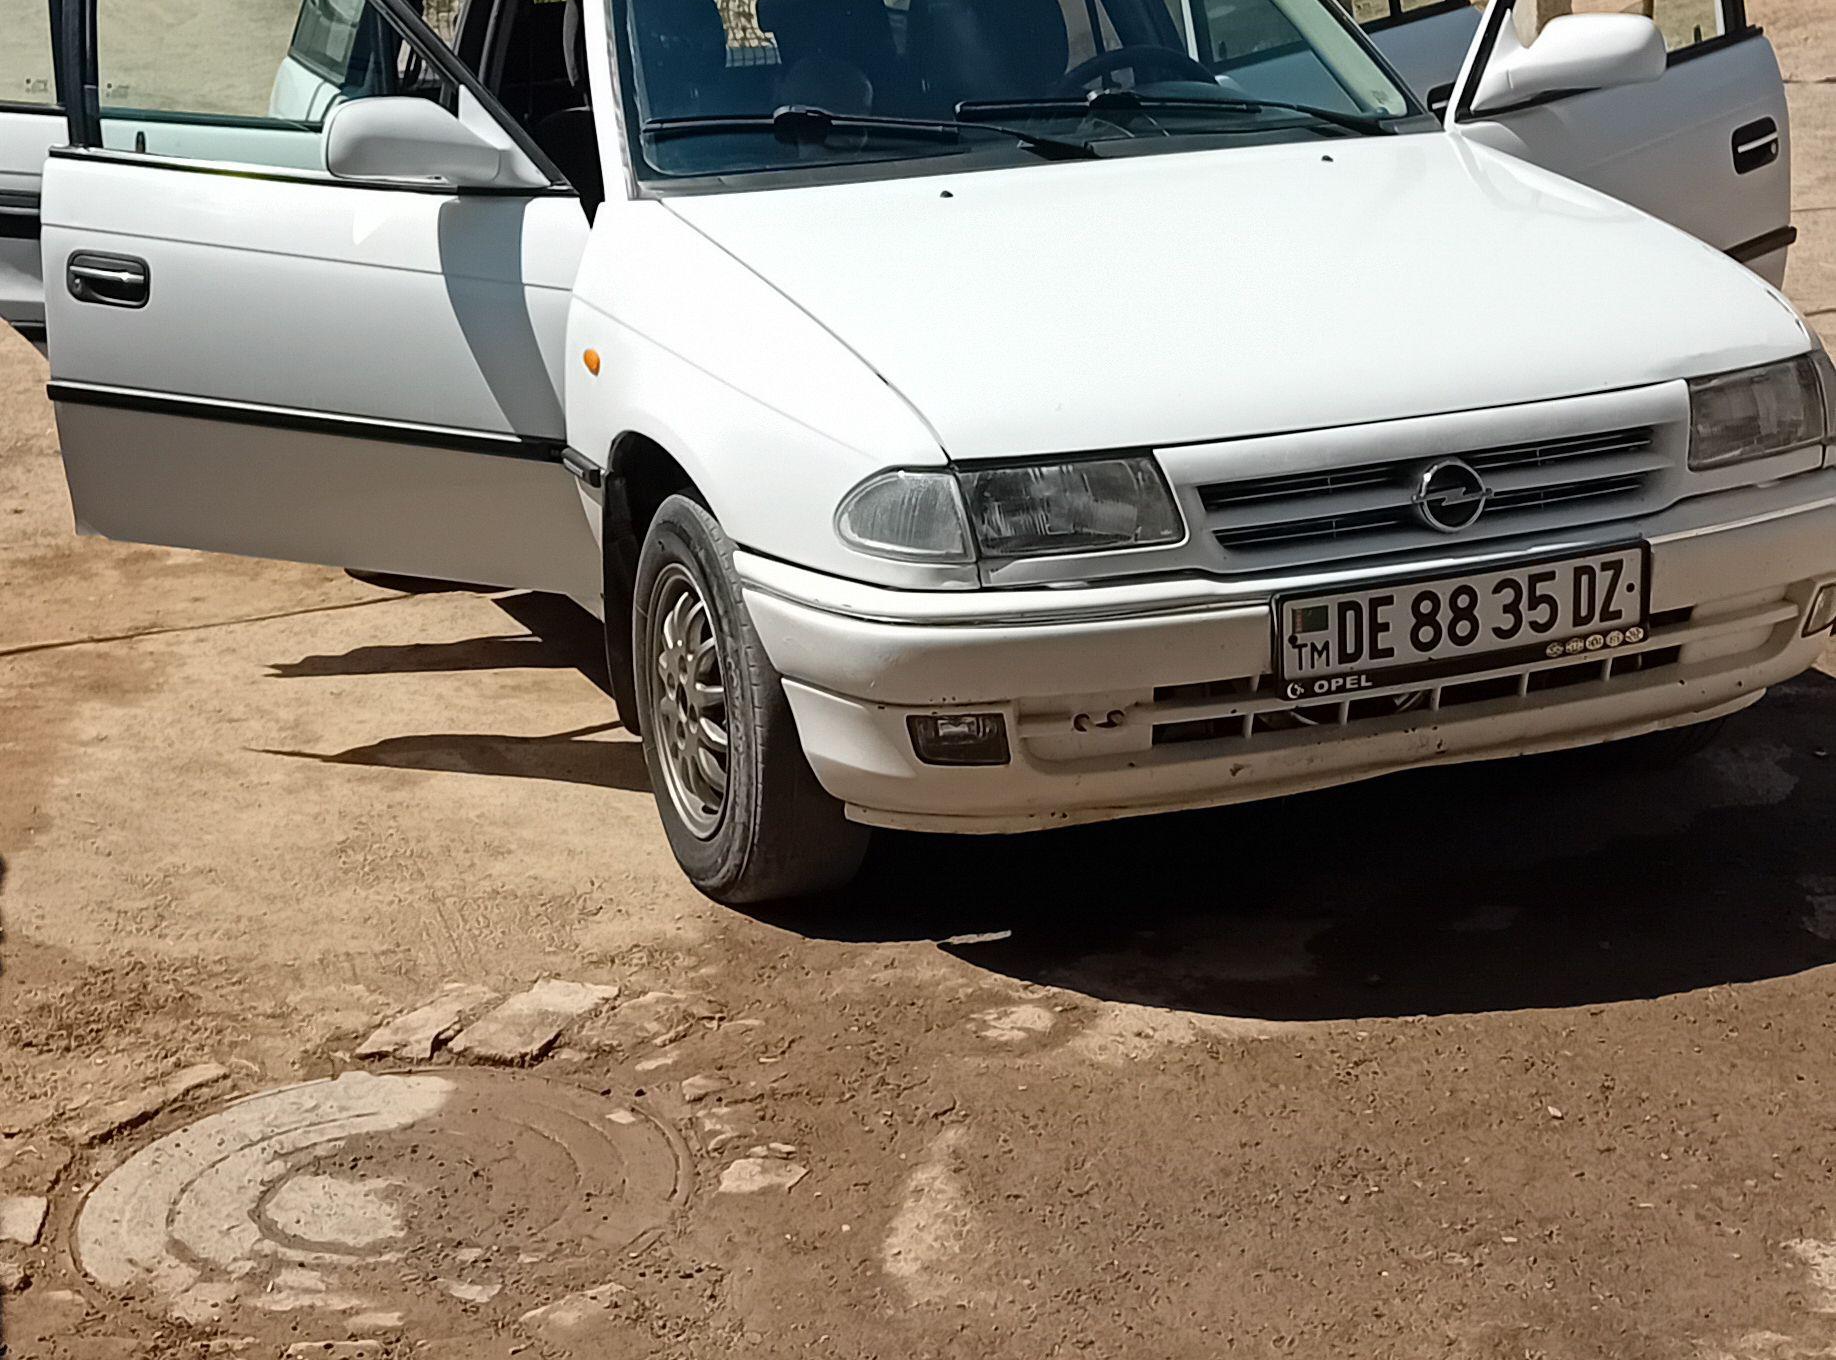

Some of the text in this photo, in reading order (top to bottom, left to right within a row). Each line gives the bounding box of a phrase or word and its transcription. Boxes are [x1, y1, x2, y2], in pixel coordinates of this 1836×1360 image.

[1337, 595, 1394, 665] DE
[1410, 584, 1480, 653] 88
[1491, 570, 1559, 640] 35
[1572, 559, 1624, 627] DZ
[1292, 640, 1330, 671] TM
[1313, 674, 1373, 694] OPEL
